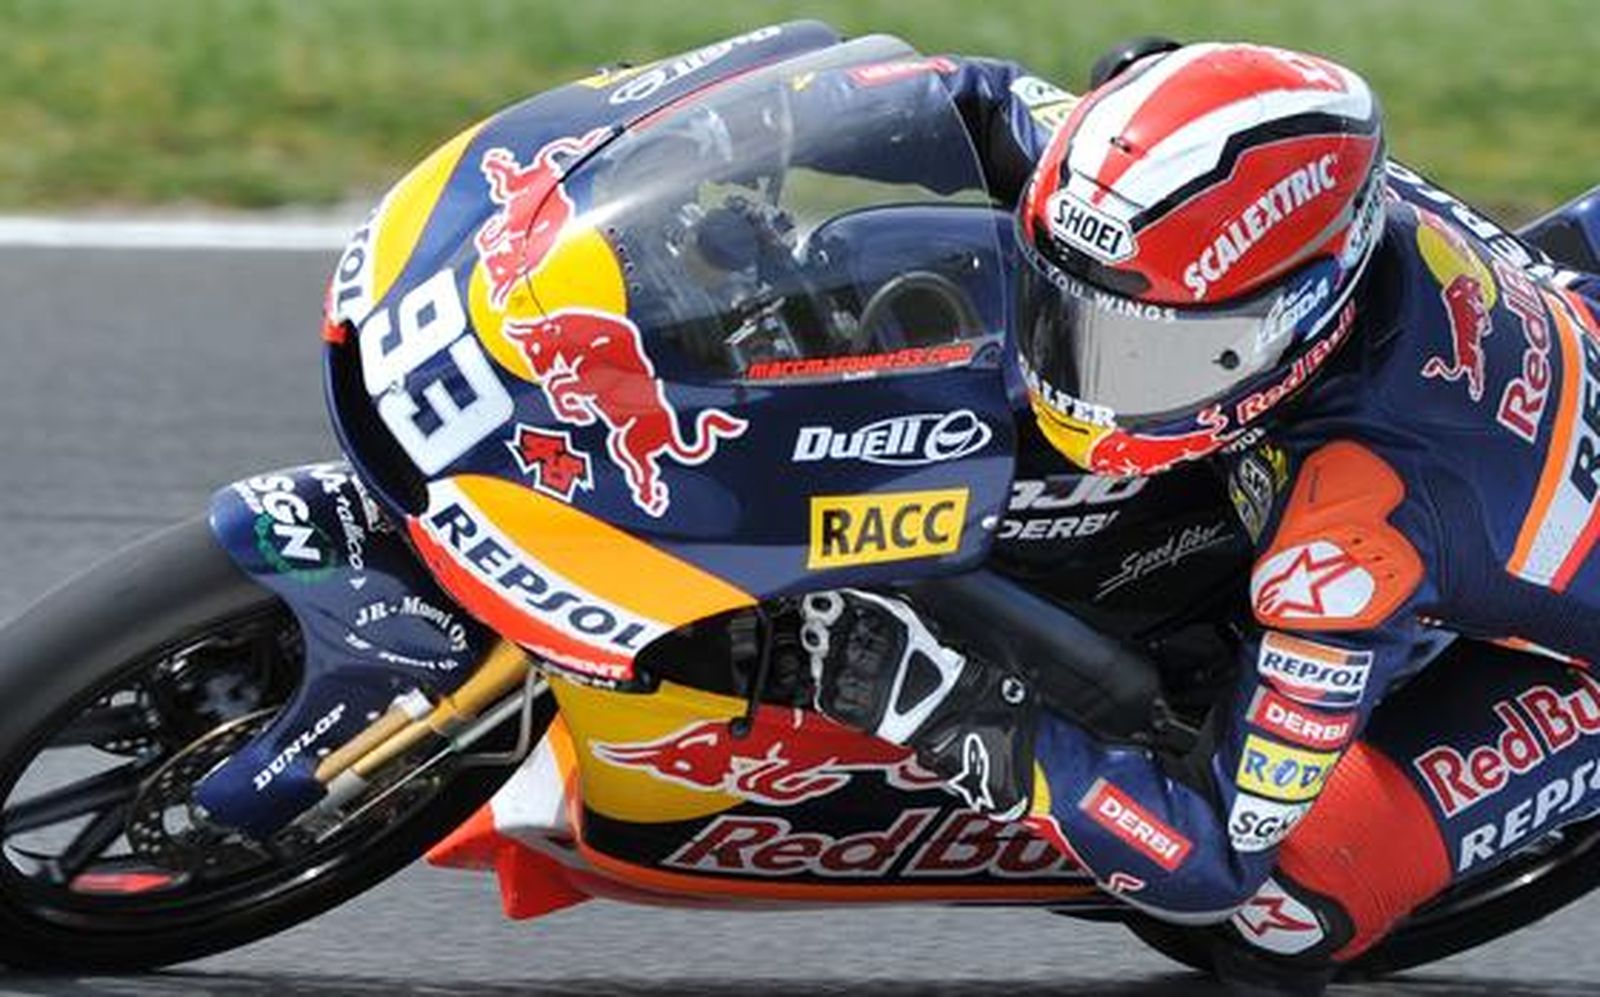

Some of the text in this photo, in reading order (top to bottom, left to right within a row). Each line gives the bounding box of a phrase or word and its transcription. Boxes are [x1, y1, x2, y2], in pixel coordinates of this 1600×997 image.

[1054, 199, 1123, 254] SHOEI
[1184, 154, 1337, 299] SCALEXTRIC
[1094, 291, 1177, 322] WINGS
[359, 267, 515, 476] 93
[248, 475, 321, 562] SGN
[822, 501, 955, 557] RACC
[430, 501, 648, 651] REPSOL
[1264, 653, 1362, 686] REPSOL
[253, 703, 346, 791] DUNLOP
[1266, 703, 1349, 741] DERBI
[1414, 685, 1600, 819] Red Bu
[663, 809, 1088, 876] Red Bu
[1099, 796, 1181, 859] DERBI
[1459, 760, 1600, 872] REPS
